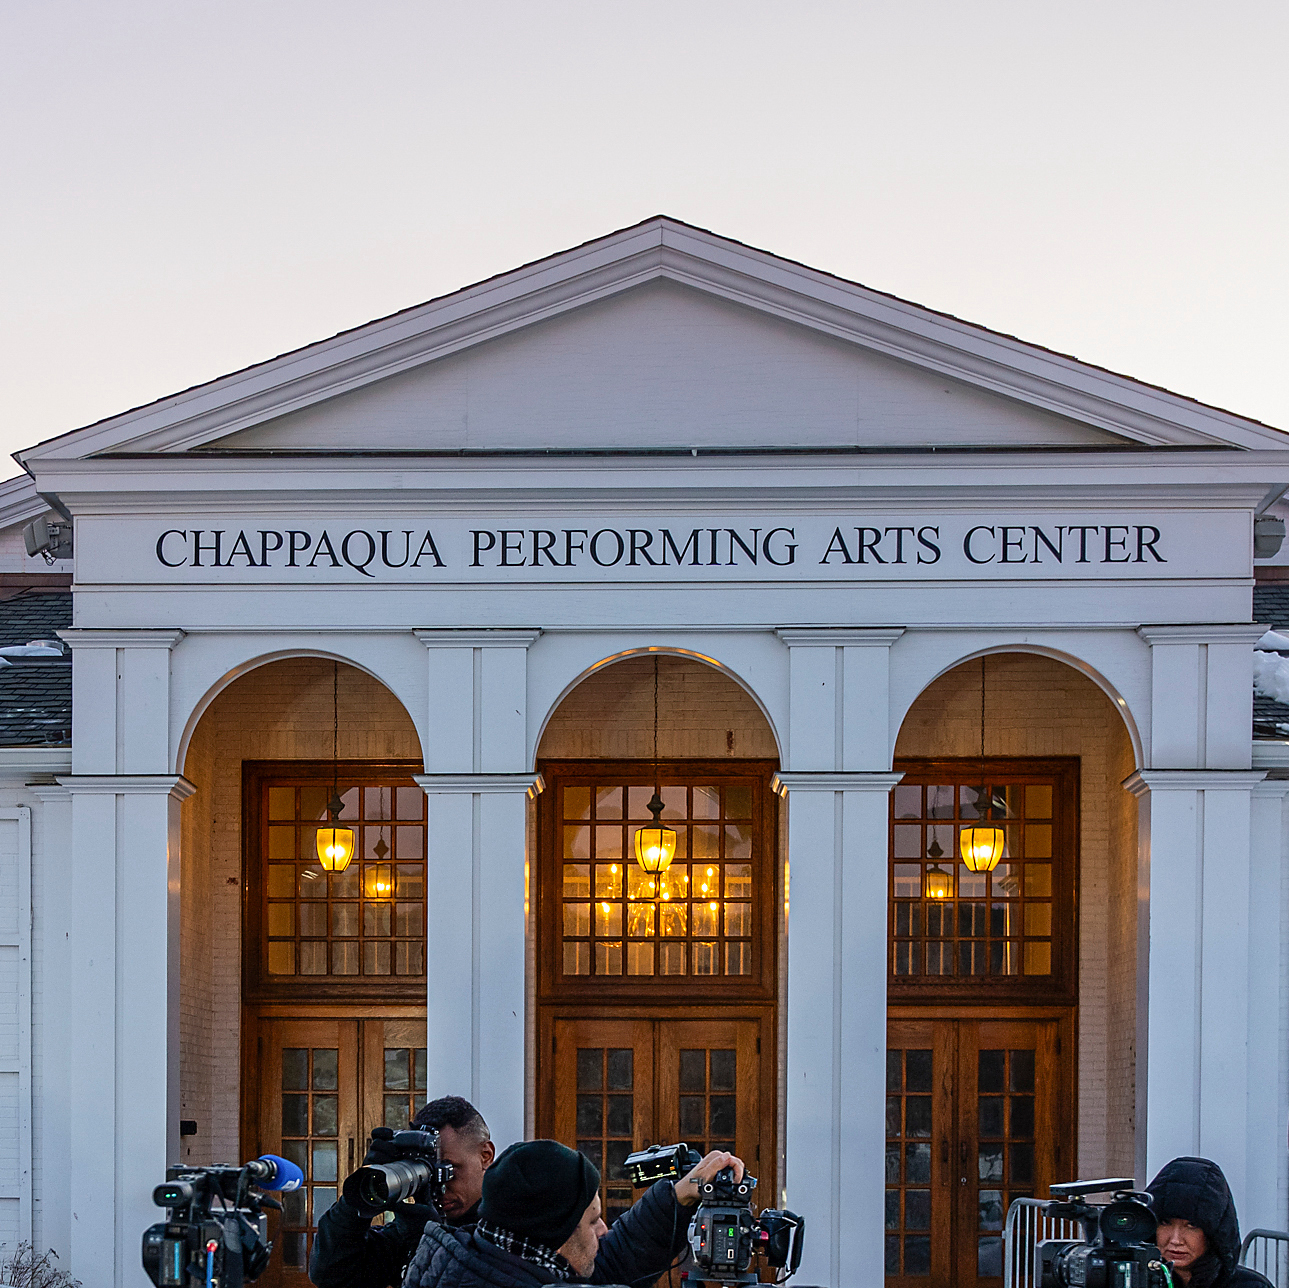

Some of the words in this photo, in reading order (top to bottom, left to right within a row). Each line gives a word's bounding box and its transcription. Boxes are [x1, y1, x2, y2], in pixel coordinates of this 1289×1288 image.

[155, 530, 448, 578] CHAPPAQUA
[469, 528, 799, 567] PERFORMING
[819, 526, 942, 565] ARTS
[964, 526, 1168, 565] CENTER
